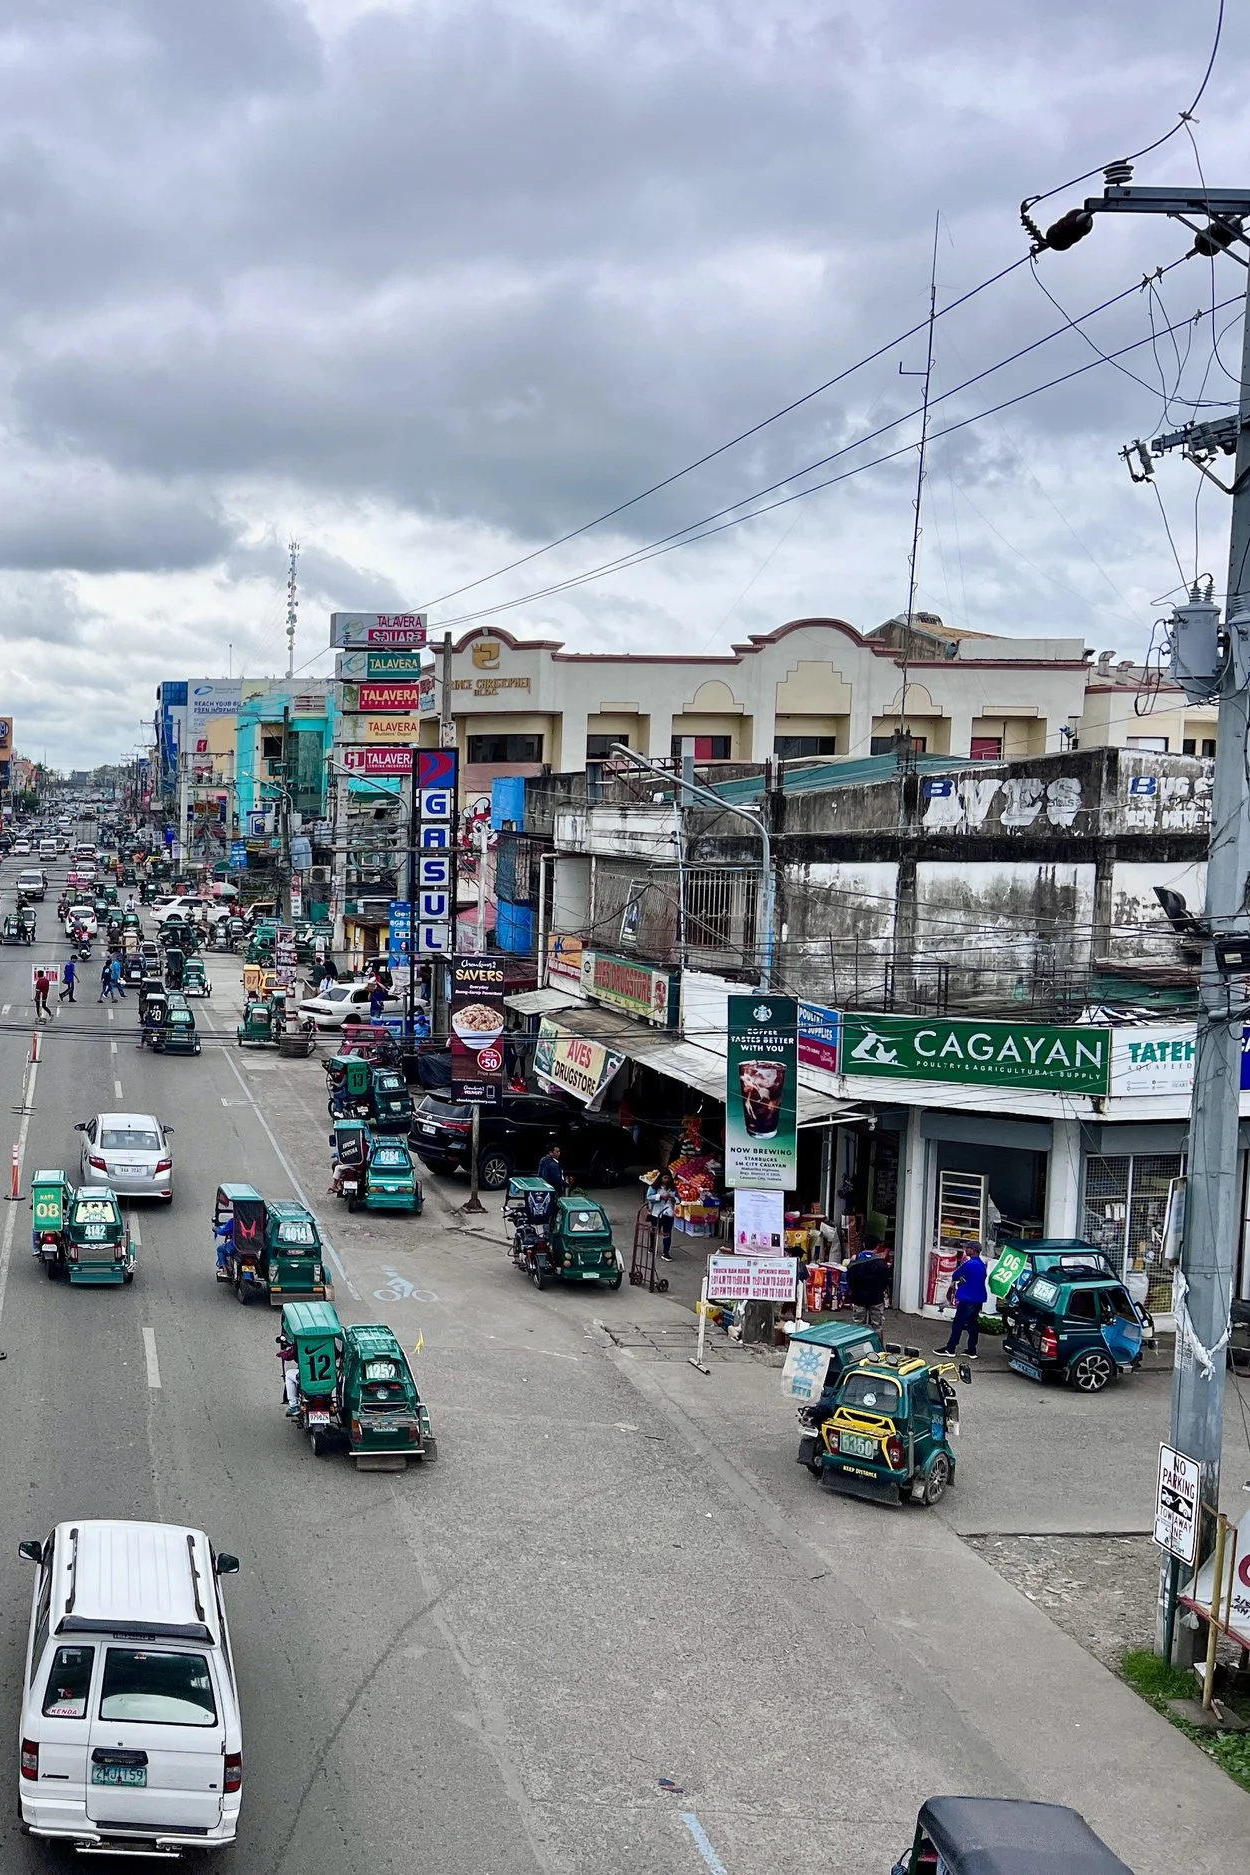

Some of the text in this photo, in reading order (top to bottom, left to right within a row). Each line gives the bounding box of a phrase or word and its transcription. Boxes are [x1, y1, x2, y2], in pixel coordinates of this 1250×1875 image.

[376, 615, 423, 628] TALAVERA
[372, 631, 423, 642] SQUARE
[369, 659, 418, 669] TALAVERA
[449, 679, 473, 690] RINCE
[361, 689, 418, 701] TALAVERA
[368, 722, 418, 732] TALAVERA
[366, 753, 413, 765] TALAVER
[424, 793, 446, 948] GASUL
[455, 969, 504, 982] SAVERS
[730, 1035, 795, 1045] TASTES BETTER
[567, 1039, 592, 1069] AVES
[740, 1044, 784, 1052] WITH YOU
[913, 1030, 1102, 1069] CAGAYAN
[915, 1060, 961, 1070] POULTRY
[972, 1064, 1054, 1078] AGRICULTURAL
[1059, 1071, 1101, 1080] SUPPLY
[353, 1072, 364, 1087] 13
[554, 1059, 597, 1097] DRUGSTORE
[730, 1146, 792, 1156] NOW BREWING
[36, 1203, 60, 1217] 08
[85, 1225, 107, 1236] 4142
[1003, 1253, 1021, 1269] 06
[992, 1269, 1013, 1284] 29
[305, 1355, 331, 1381] 12
[842, 1465, 855, 1473] KEEP
[1173, 1455, 1187, 1476] NO
[1162, 1467, 1195, 1500] PARKING
[1159, 1506, 1192, 1536] TOW AWAY
